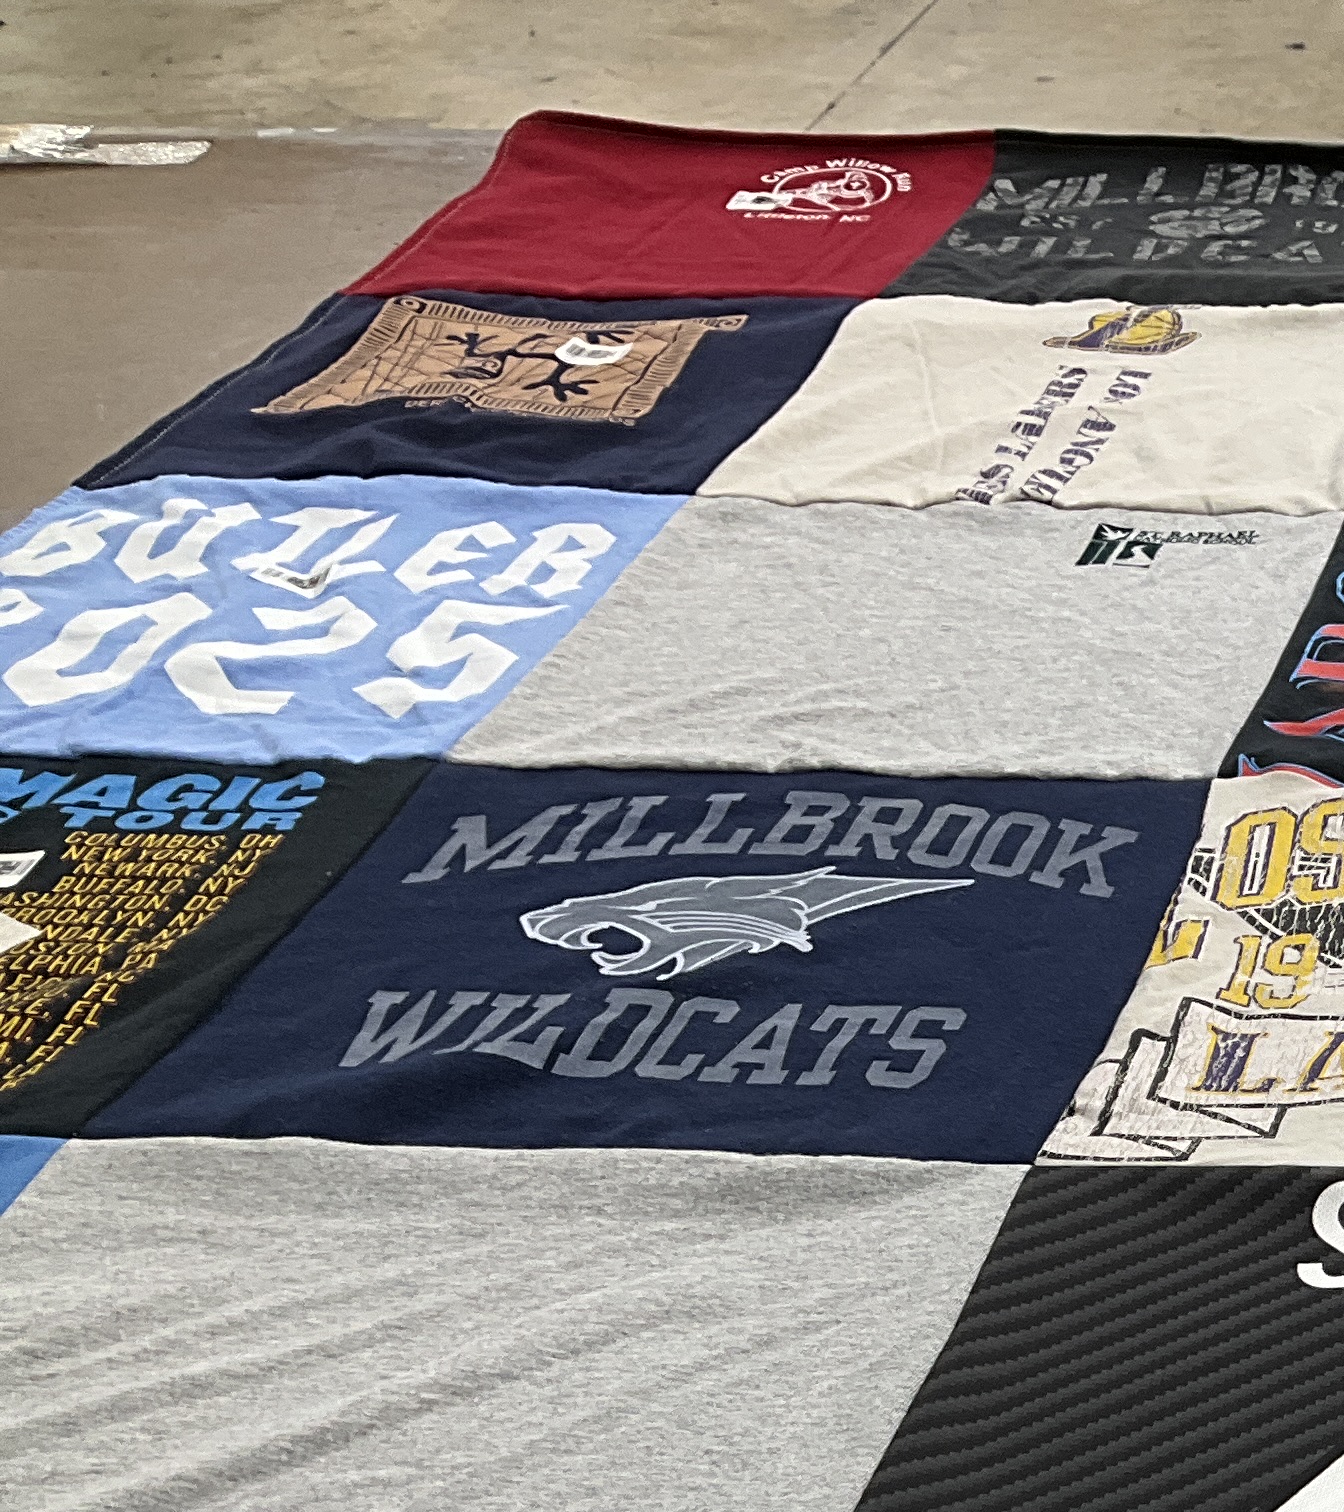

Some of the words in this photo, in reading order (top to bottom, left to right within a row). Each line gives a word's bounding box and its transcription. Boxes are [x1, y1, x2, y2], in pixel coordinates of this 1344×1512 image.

[760, 164, 819, 183] Camp
[825, 157, 897, 173] Willow
[0, 497, 618, 598] BUTLER
[0, 766, 326, 811] MAGIC
[60, 806, 303, 831] TOUR
[239, 832, 286, 850] OH
[402, 790, 1140, 898] MILLBROOK
[60, 845, 134, 862] NEW
[228, 848, 272, 865] NY
[199, 876, 246, 895] NY
[184, 895, 230, 912] DC
[168, 911, 217, 928] NY
[1218, 932, 1319, 1010] 19
[64, 1000, 101, 1026] FL
[46, 1023, 84, 1045] FL
[339, 987, 970, 1089] WILDCATS
